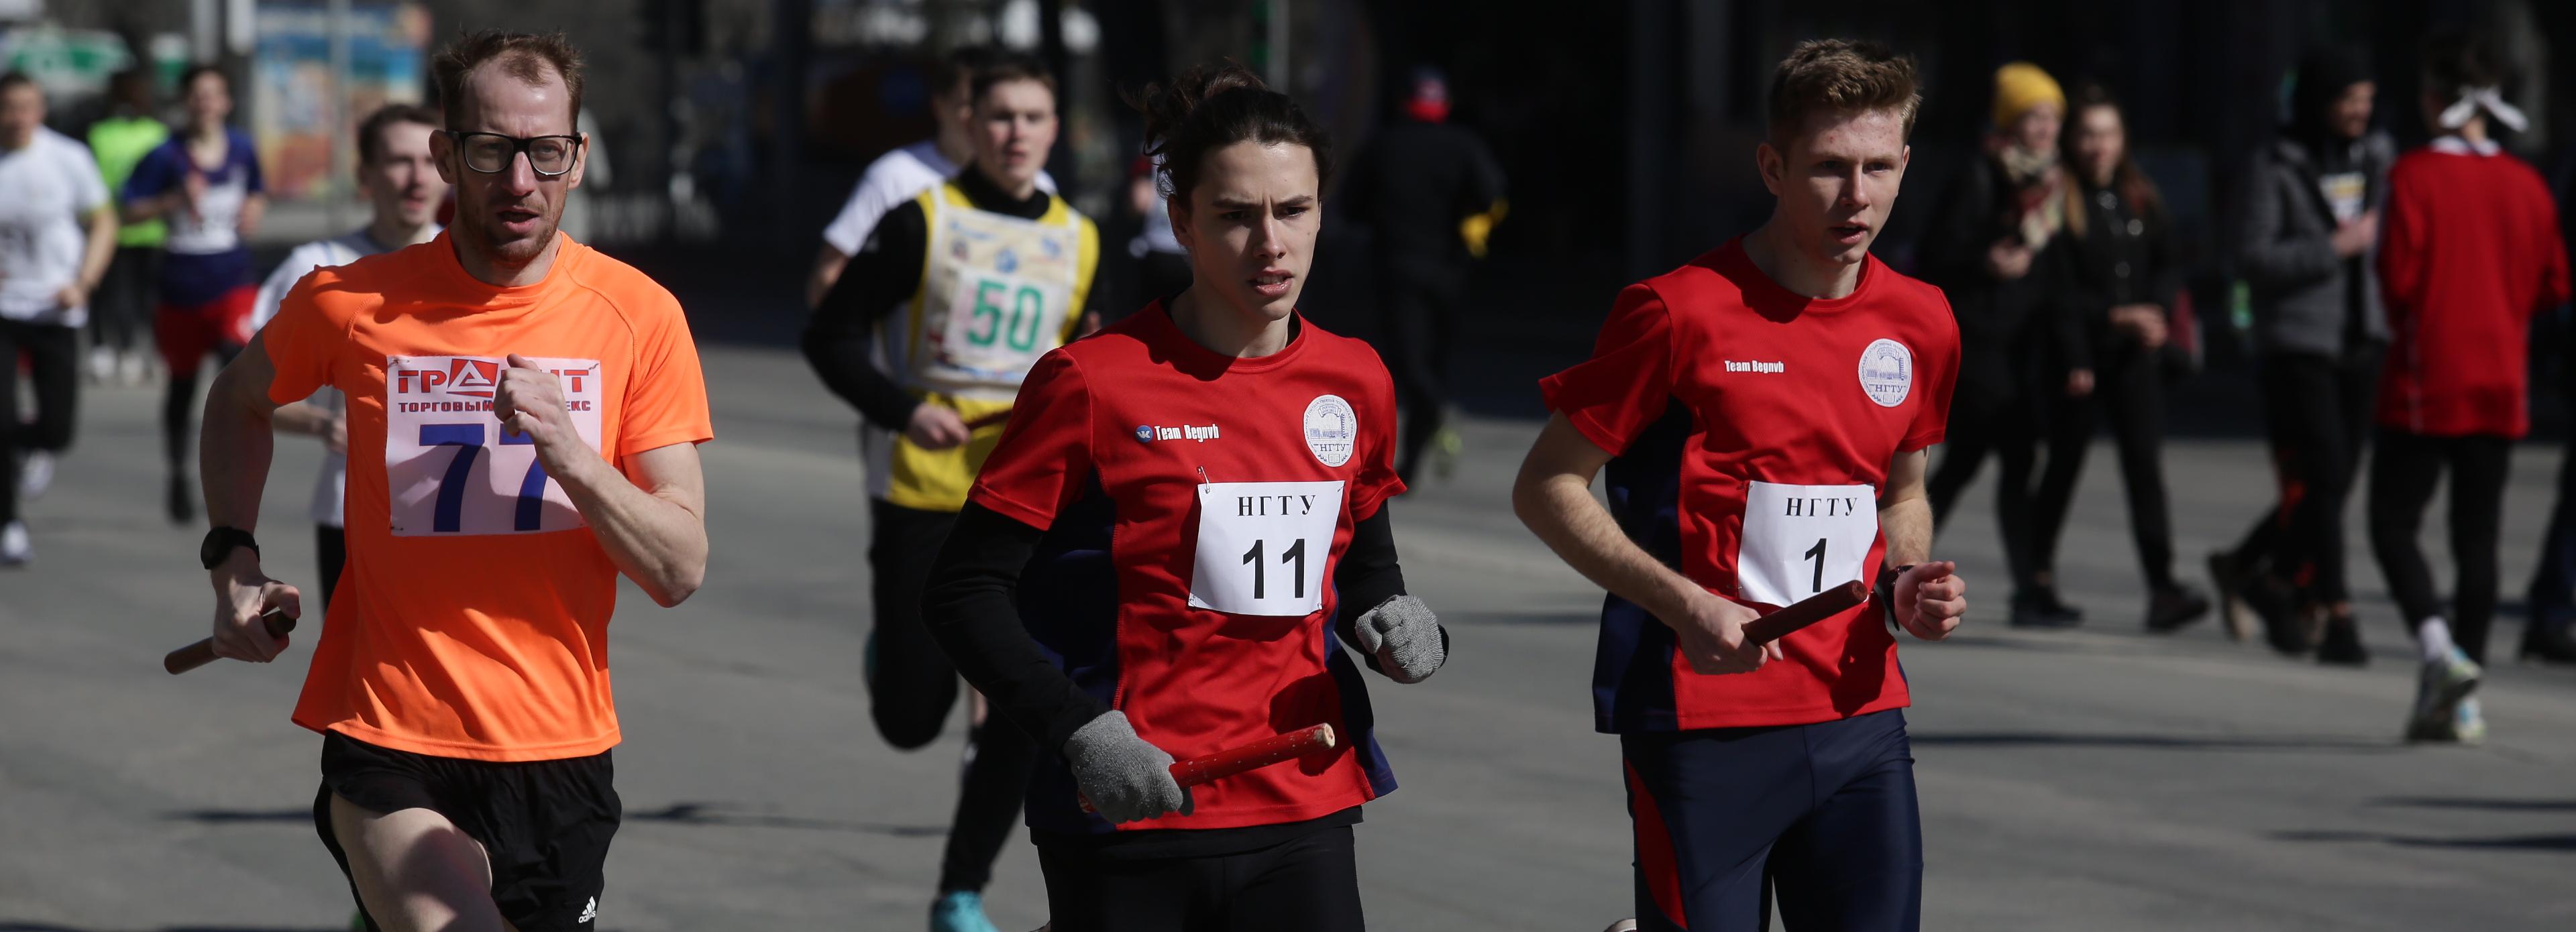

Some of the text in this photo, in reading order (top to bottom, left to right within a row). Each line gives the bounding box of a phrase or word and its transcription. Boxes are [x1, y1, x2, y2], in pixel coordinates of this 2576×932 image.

[968, 279, 1042, 353] 50
[398, 358, 589, 398] ГРАТ
[1725, 359, 1784, 374] Team Begnvb
[1154, 425, 1182, 441] Team
[1183, 423, 1220, 443] Begnvb
[419, 423, 548, 532] 77
[1236, 495, 1316, 516] НГТУ
[1784, 497, 1858, 516] НГТУ
[1242, 538, 1305, 599] 11
[1804, 538, 1827, 593] 1
